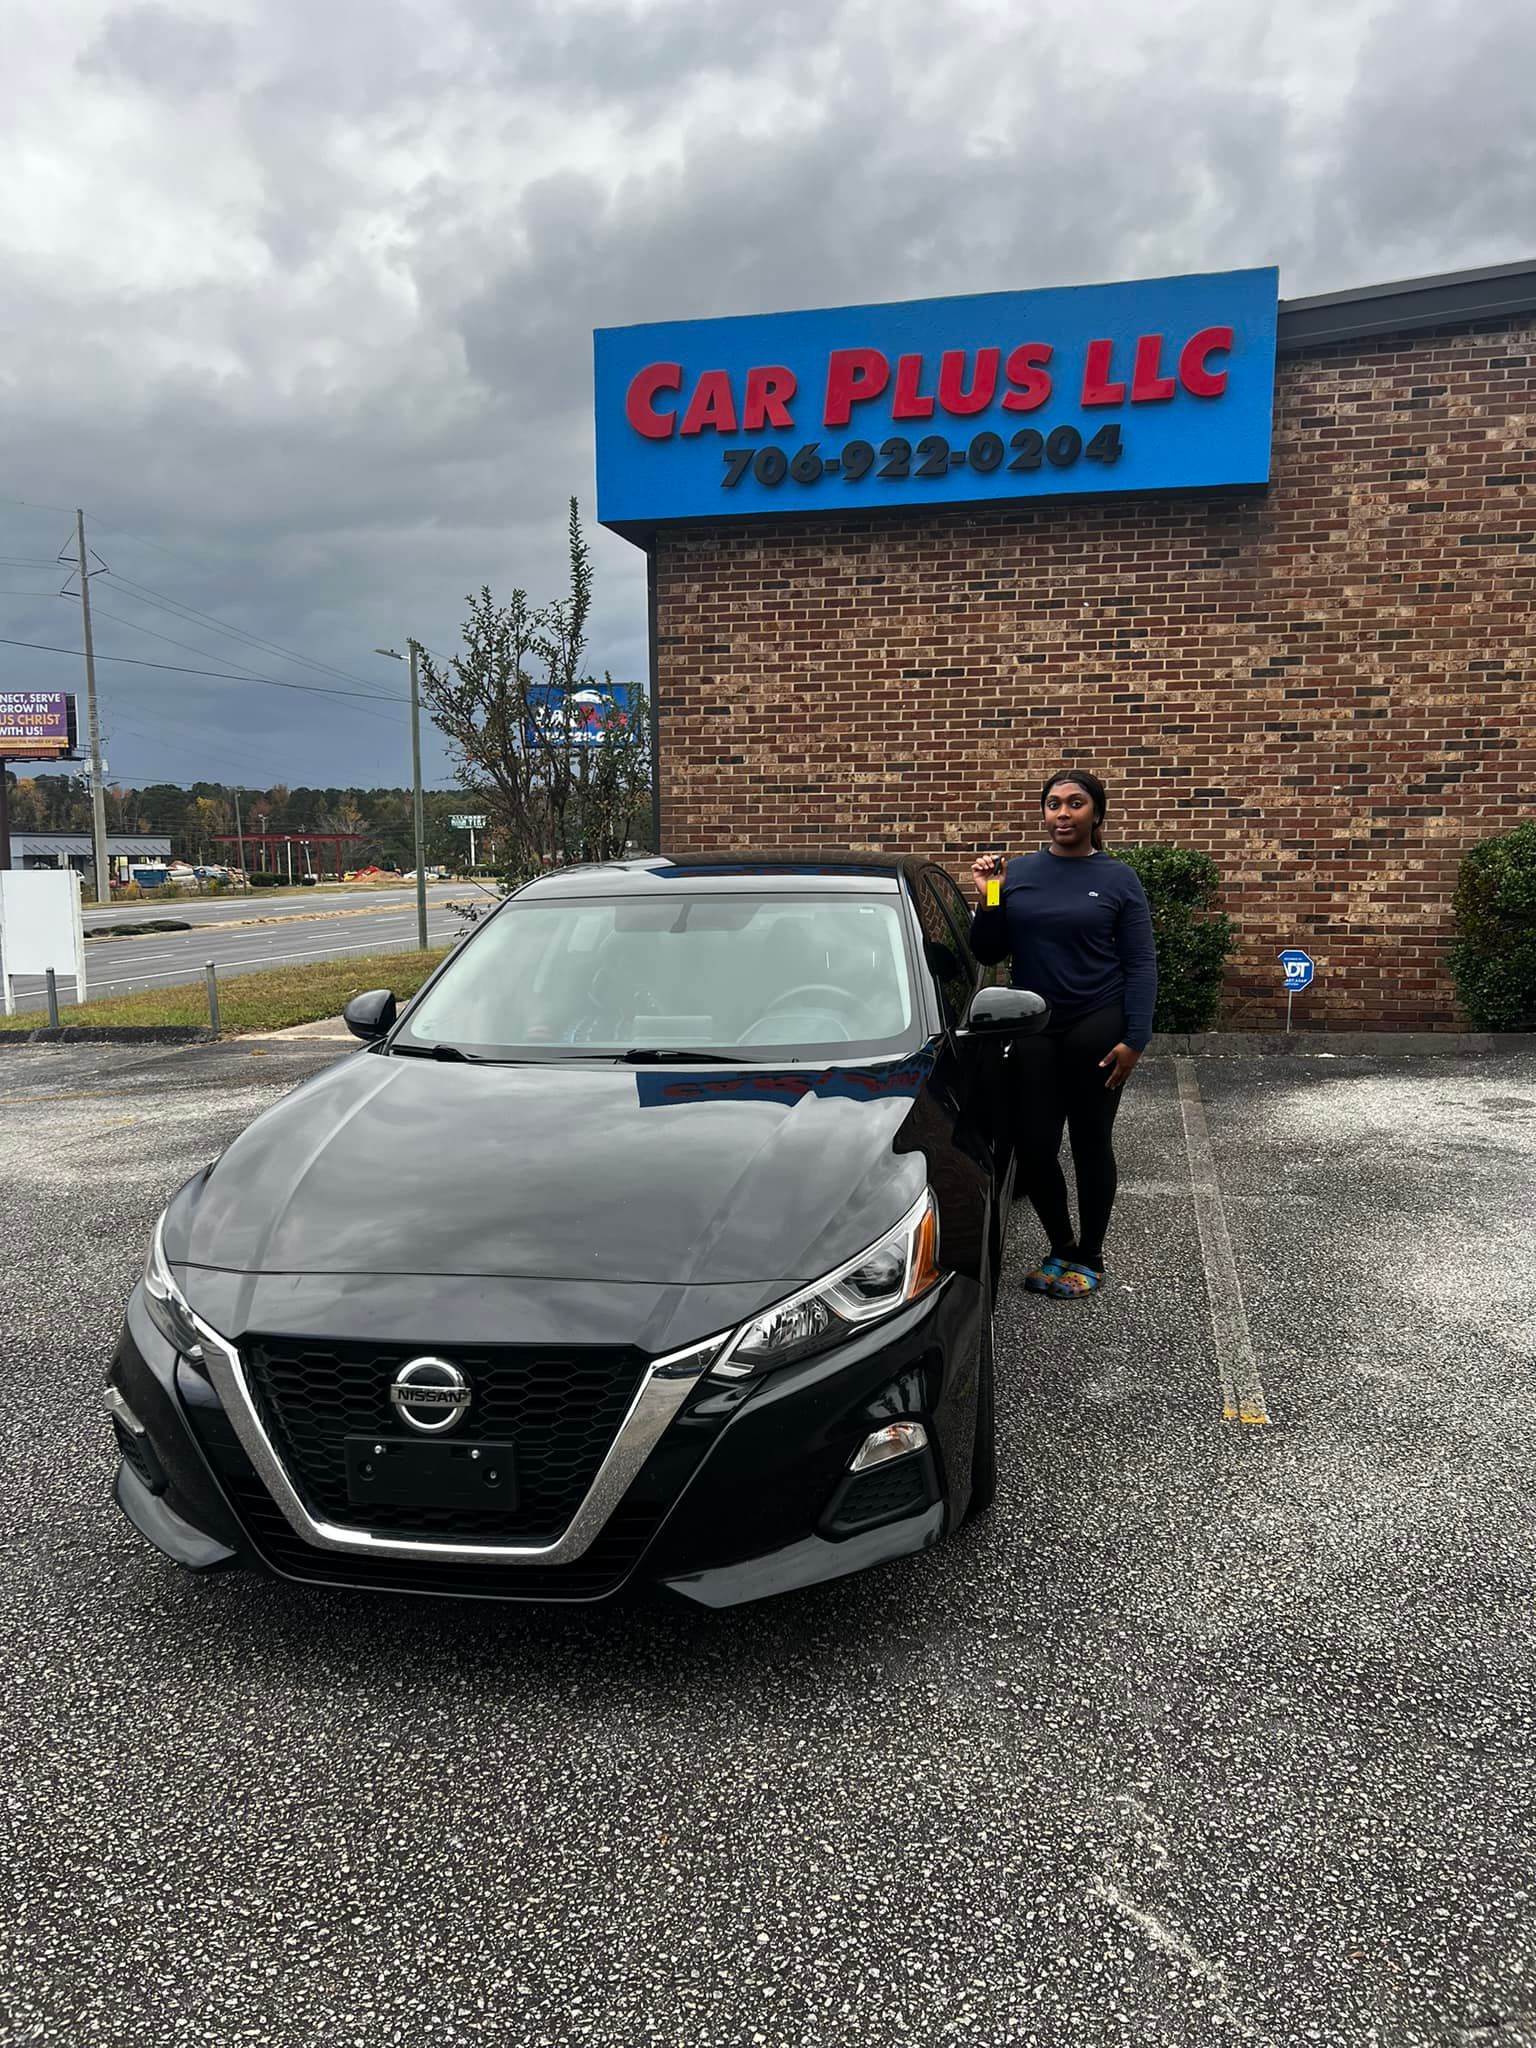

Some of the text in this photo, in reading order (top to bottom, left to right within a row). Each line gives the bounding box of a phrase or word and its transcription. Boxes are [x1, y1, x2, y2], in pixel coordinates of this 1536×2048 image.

[625, 326, 1234, 440] CAR PLUS LLC
[720, 423, 1124, 488] 706-922-0204
[30, 693, 61, 703] SERVE
[0, 703, 48, 713] GROW IN
[17, 713, 60, 726] CHRIST
[0, 726, 44, 736] WITH US!
[398, 1388, 463, 1404] NISSAN
